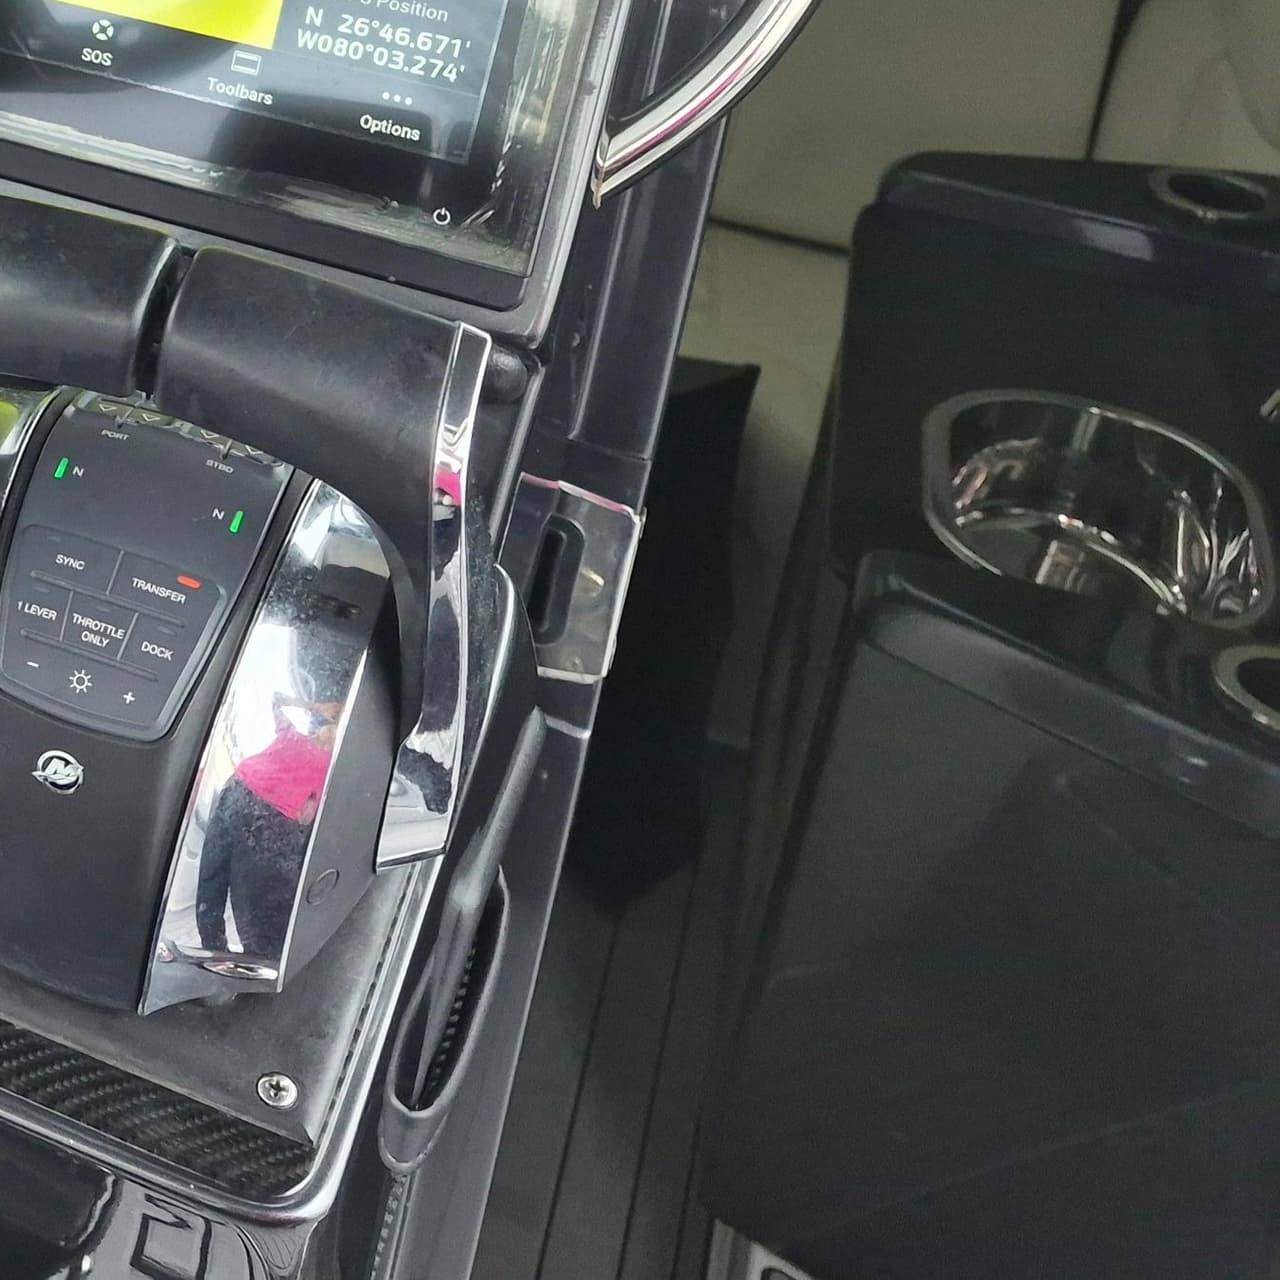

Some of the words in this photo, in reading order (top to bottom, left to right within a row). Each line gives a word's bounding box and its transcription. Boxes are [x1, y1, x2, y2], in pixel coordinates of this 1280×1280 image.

[305, 6, 324, 27] N
[81, 47, 114, 67] SOS
[207, 76, 273, 106] Toolbars
[359, 114, 421, 142] Options
[101, 429, 130, 441] PORT
[72, 466, 84, 477] N
[206, 459, 234, 473] STBD
[212, 508, 225, 520] N
[55, 554, 86, 570] SYNC
[132, 577, 187, 605] TRANSFER
[24, 603, 57, 621] LEVER
[72, 613, 126, 640] THROTTLE
[81, 632, 110, 649] ONLY
[141, 641, 174, 661] DOCK
